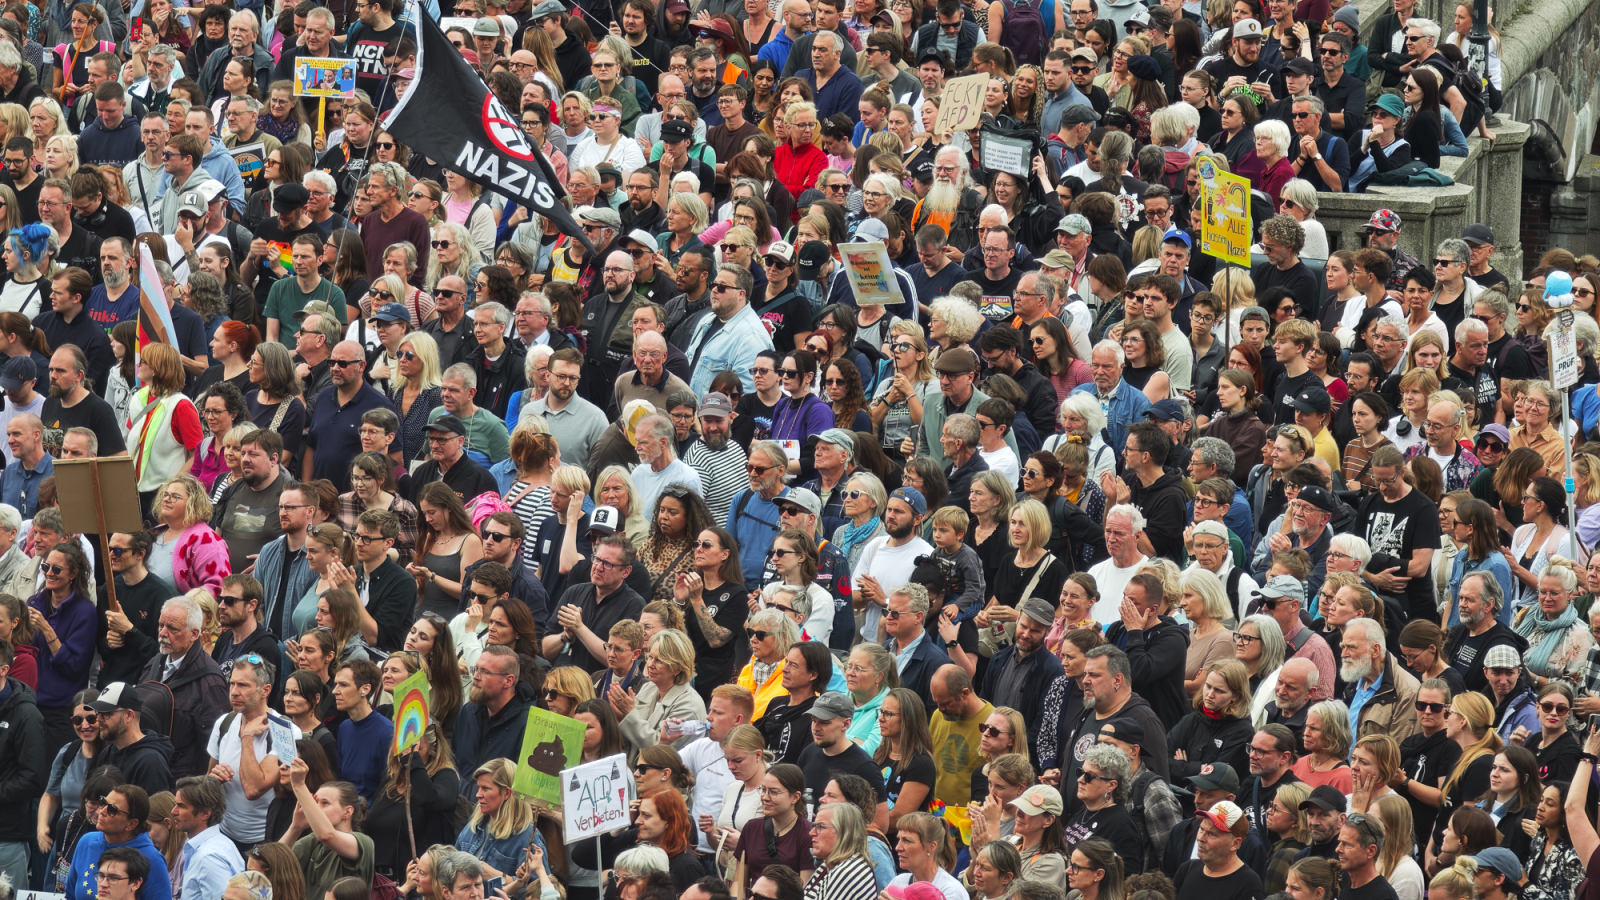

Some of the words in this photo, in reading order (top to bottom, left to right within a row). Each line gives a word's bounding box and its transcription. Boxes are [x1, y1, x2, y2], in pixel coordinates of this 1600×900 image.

[937, 105, 969, 130] AFD
[455, 141, 555, 209] NAZIS
[1206, 226, 1228, 245] hassen
[1227, 240, 1247, 258] Nazis
[1227, 218, 1246, 236] ALLE
[577, 775, 613, 812] AfD
[573, 790, 625, 832] verbieten!
